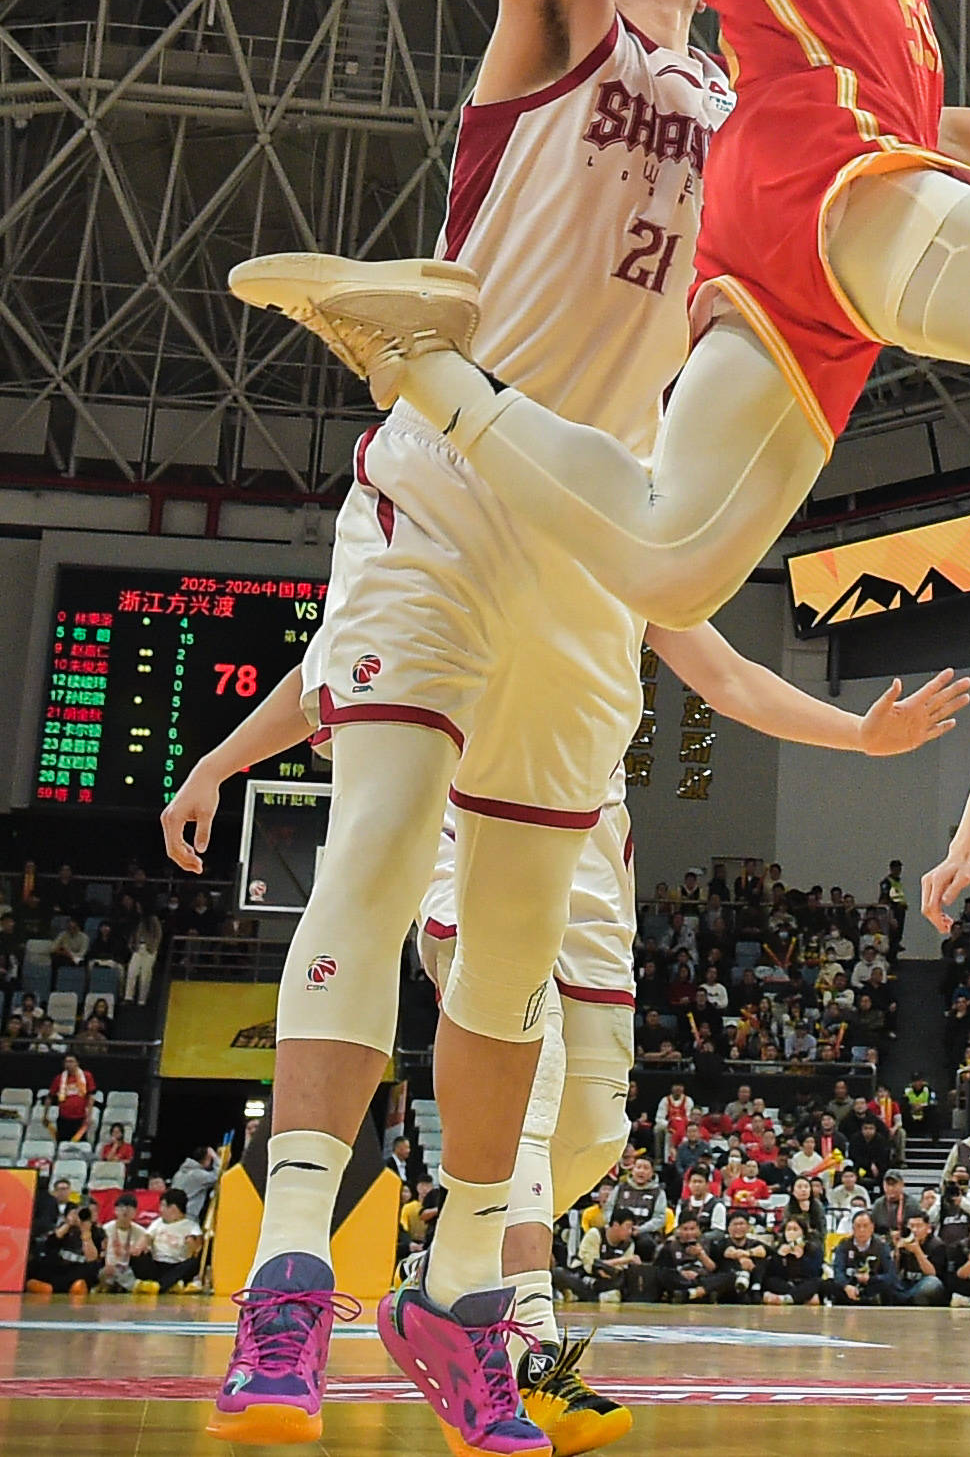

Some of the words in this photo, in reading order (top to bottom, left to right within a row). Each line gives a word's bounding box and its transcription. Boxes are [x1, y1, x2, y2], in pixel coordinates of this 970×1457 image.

[610, 215, 683, 296] 21
[118, 590, 235, 618] 浙江方兴渡
[295, 602, 318, 620] VS
[180, 617, 189, 629] 4
[56, 626, 65, 638] 5
[180, 633, 194, 645] 15
[299, 631, 308, 642] 4
[176, 648, 185, 660] 2
[54, 659, 67, 671] 10
[52, 674, 66, 686] 12
[173, 680, 182, 692] 0
[213, 663, 258, 697] 78
[50, 690, 64, 702] 17
[172, 695, 181, 707] 5
[46, 706, 61, 718] 21
[171, 711, 180, 724] 7
[44, 721, 61, 734] 22
[42, 738, 59, 750] 23
[168, 744, 183, 756] 10
[40, 754, 57, 766] 25
[165, 759, 174, 771] 5
[163, 776, 172, 788] 0
